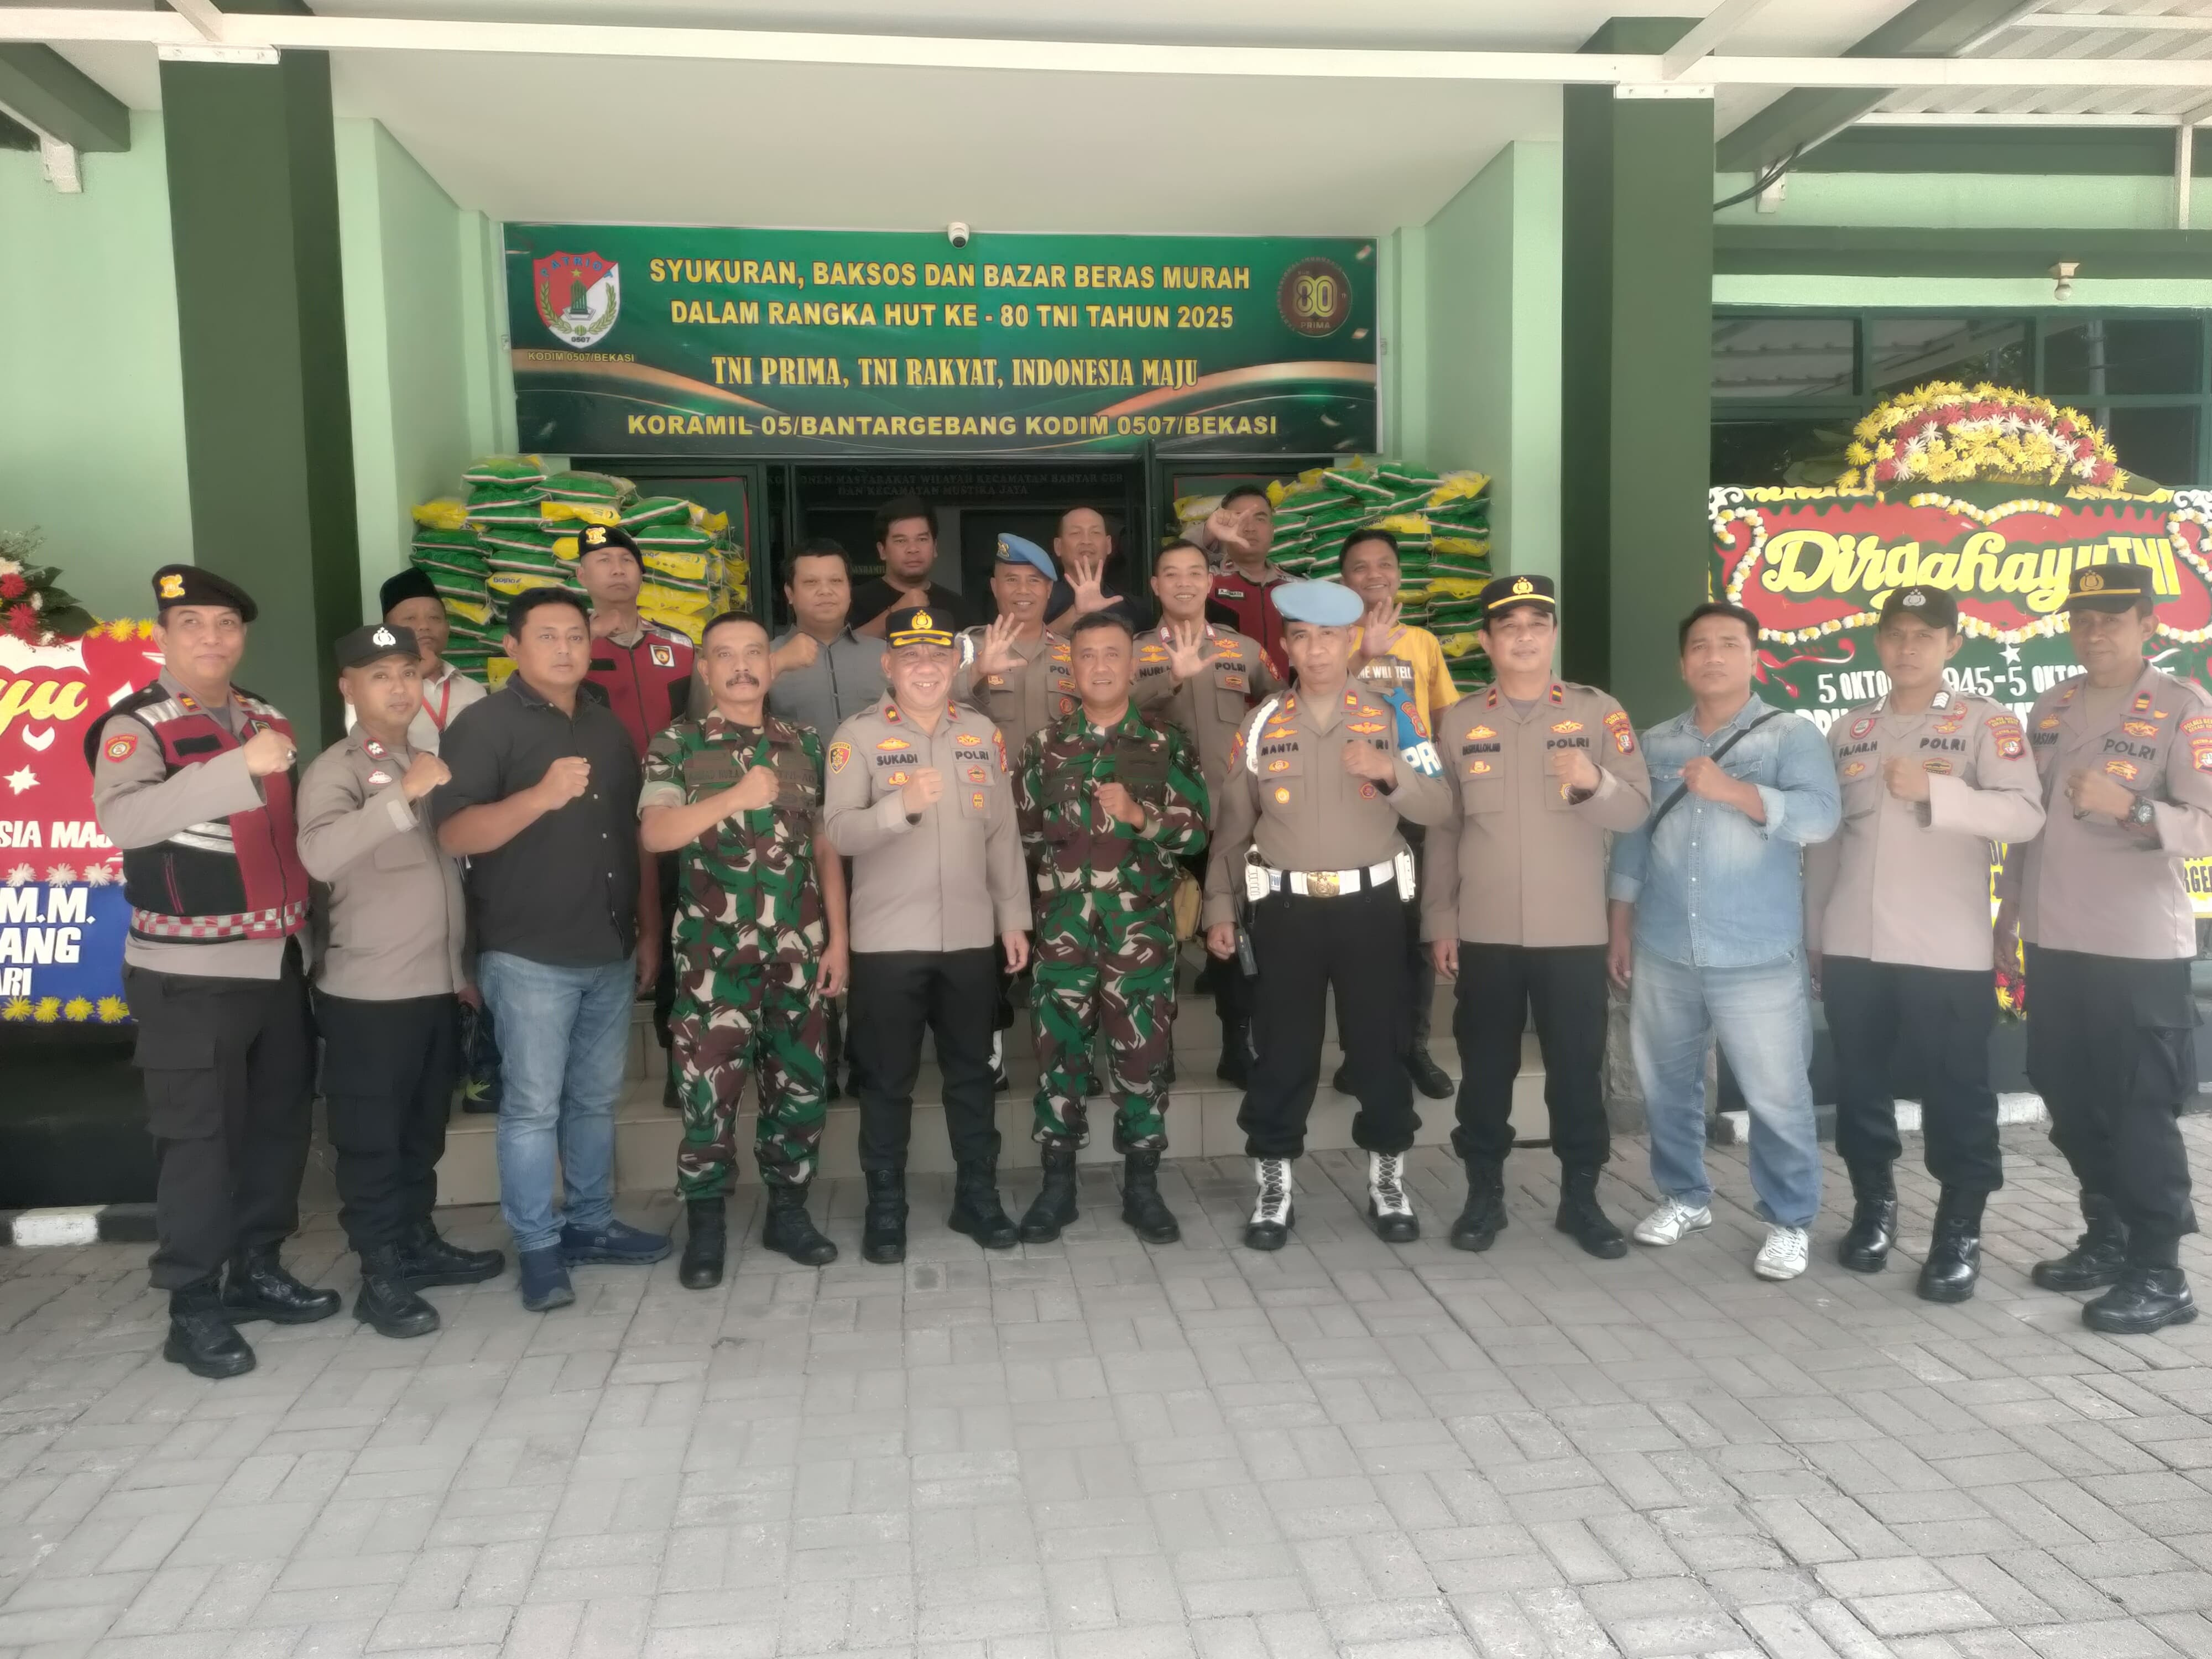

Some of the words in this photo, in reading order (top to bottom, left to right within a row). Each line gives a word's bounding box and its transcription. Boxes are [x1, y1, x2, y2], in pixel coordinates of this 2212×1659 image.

[650, 258, 805, 290] SYUKURAN,
[813, 261, 917, 286] BAKSOS
[925, 263, 975, 287] DAN
[984, 264, 1066, 288] BAZAR
[1074, 264, 1155, 288] BERAS
[1162, 266, 1250, 290] MURAH
[671, 300, 759, 324] DALAM
[768, 302, 877, 326] RANGKA
[884, 302, 937, 326] HUT
[944, 304, 978, 326] KE
[1000, 304, 1029, 327] 80
[1036, 305, 1078, 327] TNI
[1086, 305, 1169, 328] TAHUN
[1177, 306, 1234, 328] 2025
[528, 351, 564, 361] KODIM
[566, 352, 635, 363] 0507/BEKASI
[711, 356, 753, 385] TNI
[761, 357, 850, 389] PRIMA,
[857, 357, 898, 386] TNI
[906, 358, 1004, 389] RAKYAT,
[1012, 358, 1135, 387] INDONESIA
[1141, 358, 1199, 389] MAJU
[628, 414, 753, 436] KORAMIL
[761, 415, 1016, 437] 05/BANTARGEBANG
[1025, 416, 1109, 435] KODIM
[1117, 415, 1277, 436] 0507/BEKASI
[1101, 473, 1124, 483] GEB
[2107, 536, 2182, 595] TNI
[1050, 665, 1071, 675] POL
[1214, 662, 1246, 673] POLRI
[1372, 665, 1392, 678] WILL
[1394, 666, 1412, 679] TELL
[1818, 672, 1837, 703] 5
[1839, 670, 1892, 700] OKTO
[1261, 742, 1299, 757] MANTA
[1547, 737, 1590, 750] POLRI
[1919, 737, 1966, 752] POLRI
[2103, 738, 2156, 761] POLRI
[876, 753, 919, 766] SUKADI
[955, 750, 989, 761] POLRI
[1401, 740, 1442, 775] PR
[0, 967, 33, 996] RI
